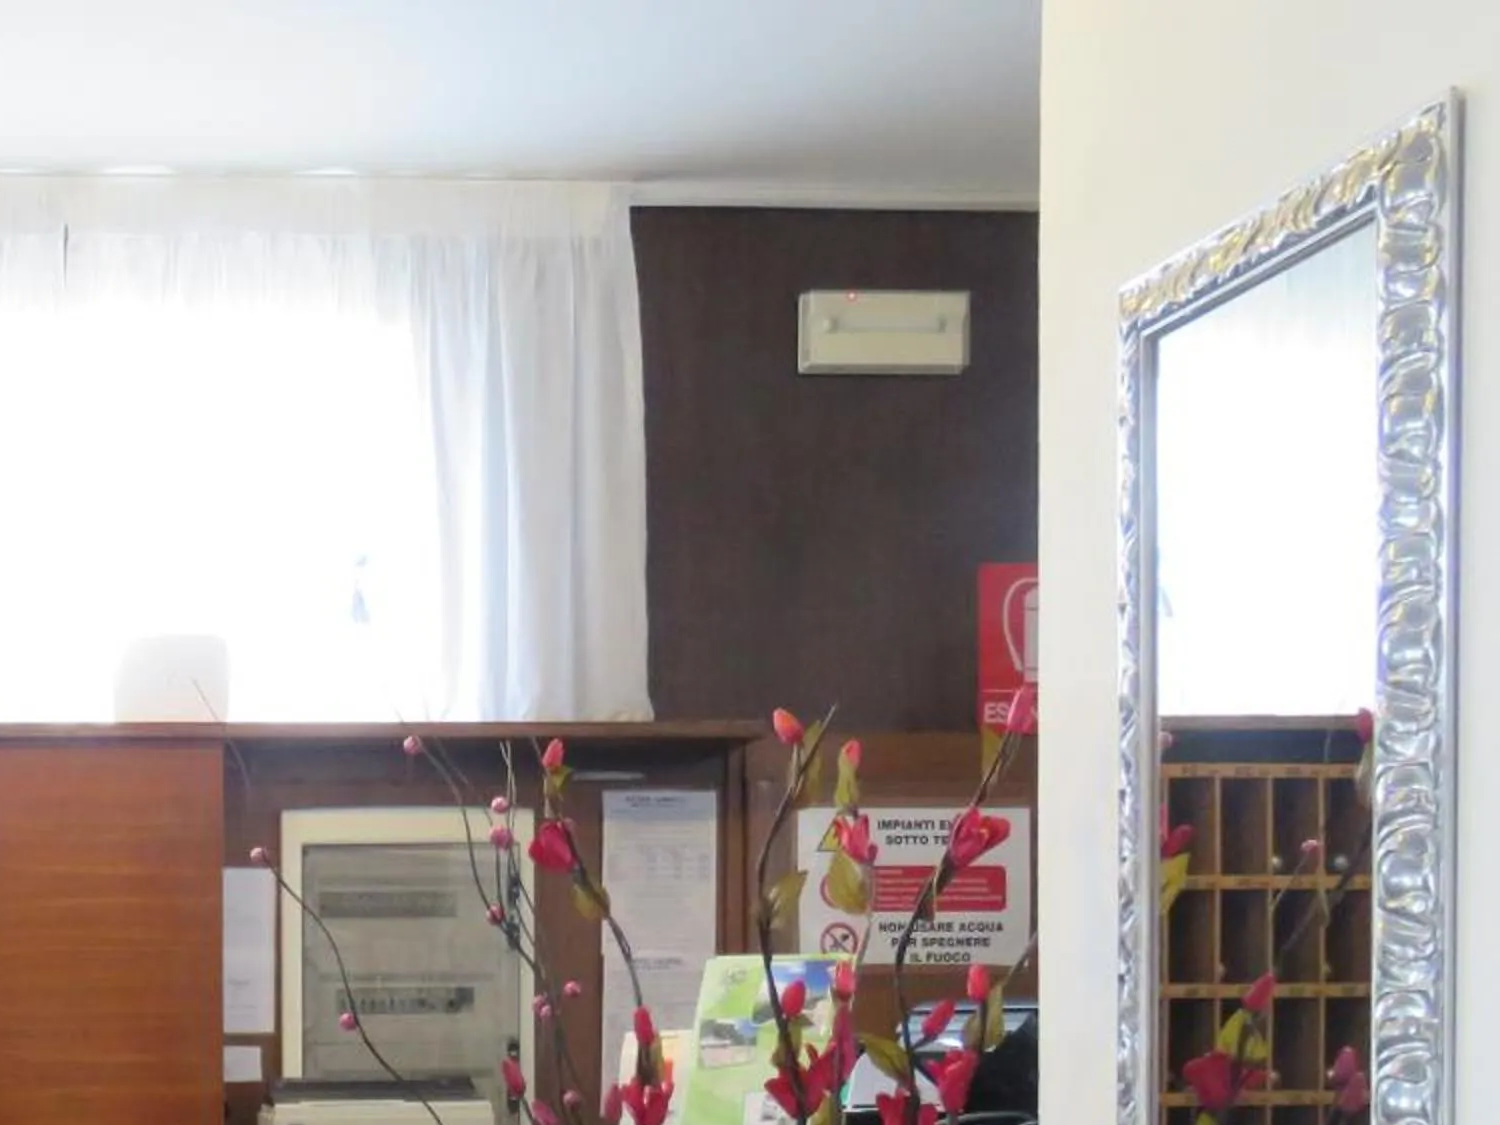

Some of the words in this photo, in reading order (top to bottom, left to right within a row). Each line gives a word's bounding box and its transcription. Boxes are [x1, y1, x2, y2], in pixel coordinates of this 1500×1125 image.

[877, 819, 935, 831] IMPIANTI
[885, 835, 929, 846] SOTTO
[958, 921, 1004, 932] ACQUA
[891, 937, 917, 948] PR
[921, 937, 992, 948] SPEGNERE
[925, 952, 971, 963] FUOCO
